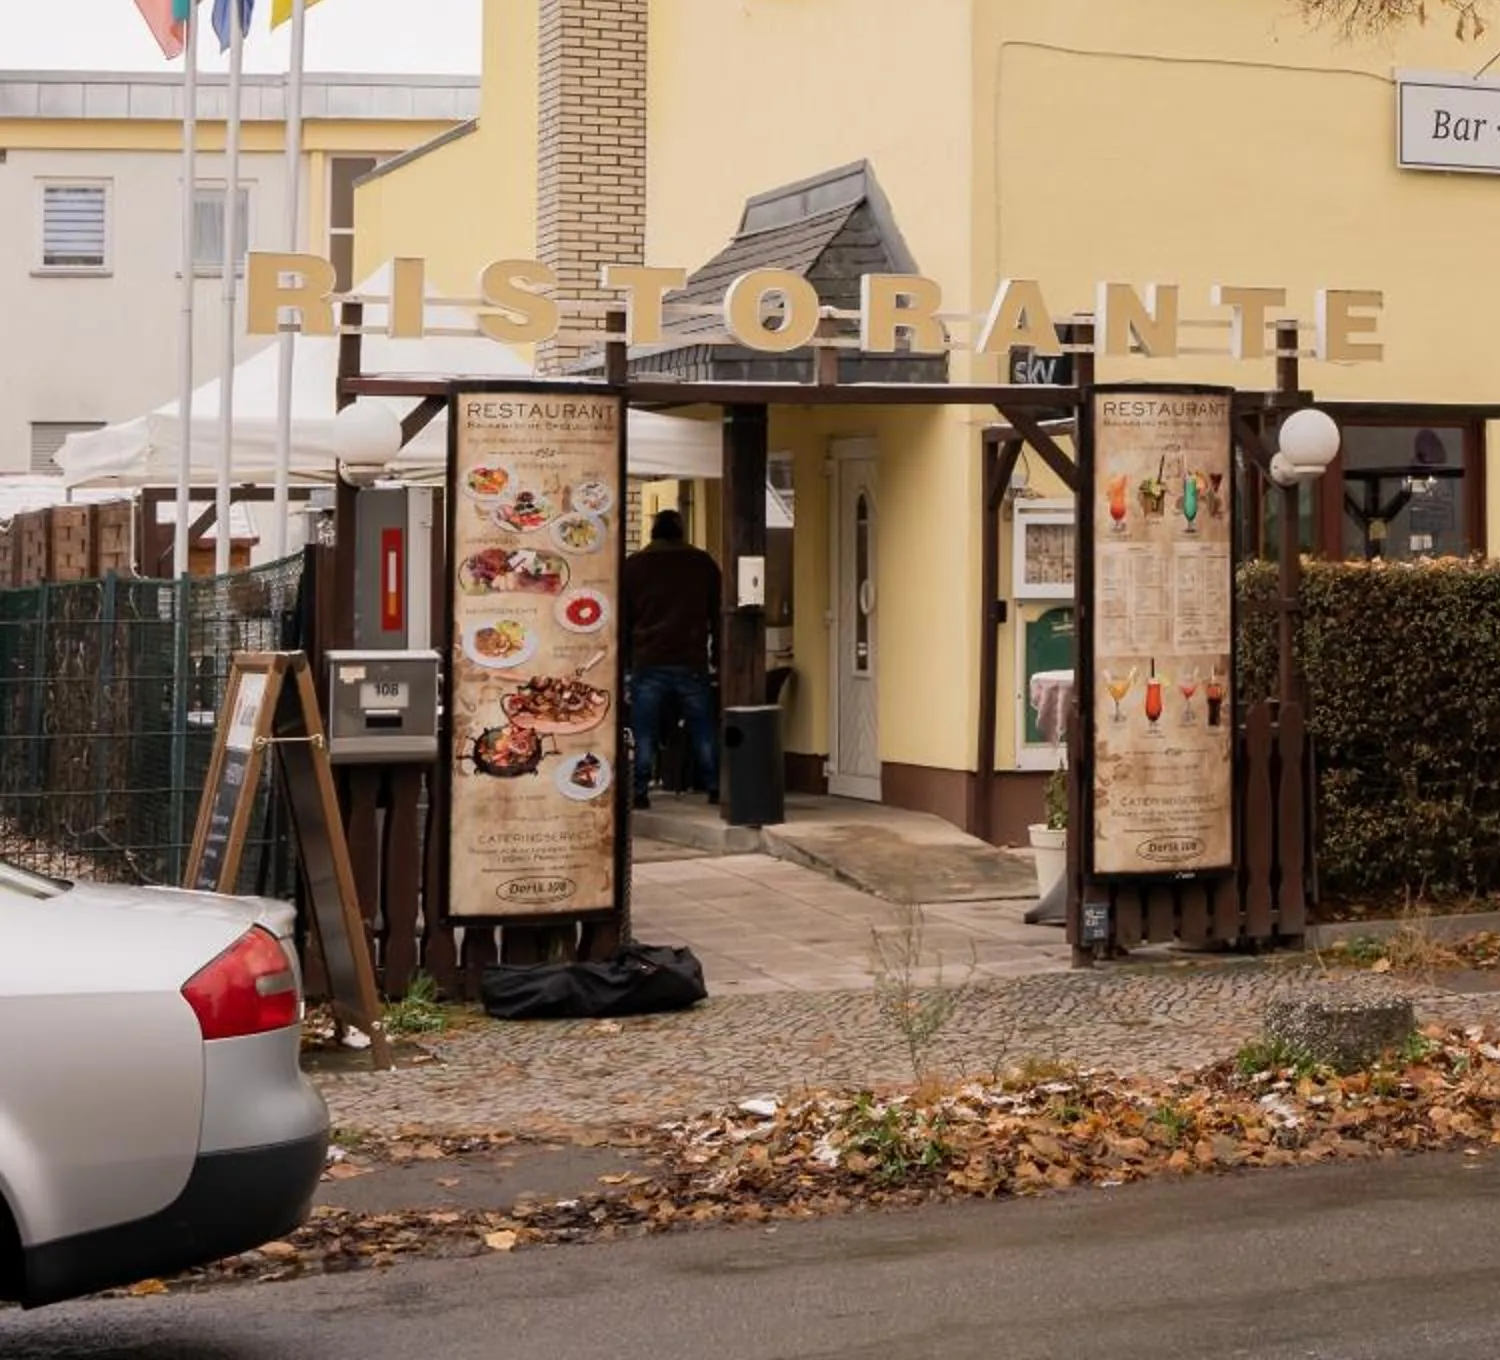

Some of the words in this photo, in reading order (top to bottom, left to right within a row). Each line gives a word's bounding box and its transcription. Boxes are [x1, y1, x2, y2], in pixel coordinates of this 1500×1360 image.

[1432, 109, 1487, 142] Bar
[246, 251, 1384, 364] RISTORANTE
[466, 401, 614, 420] RESTAURANT
[1103, 400, 1226, 417] RESTAURANT
[374, 682, 399, 698] 108
